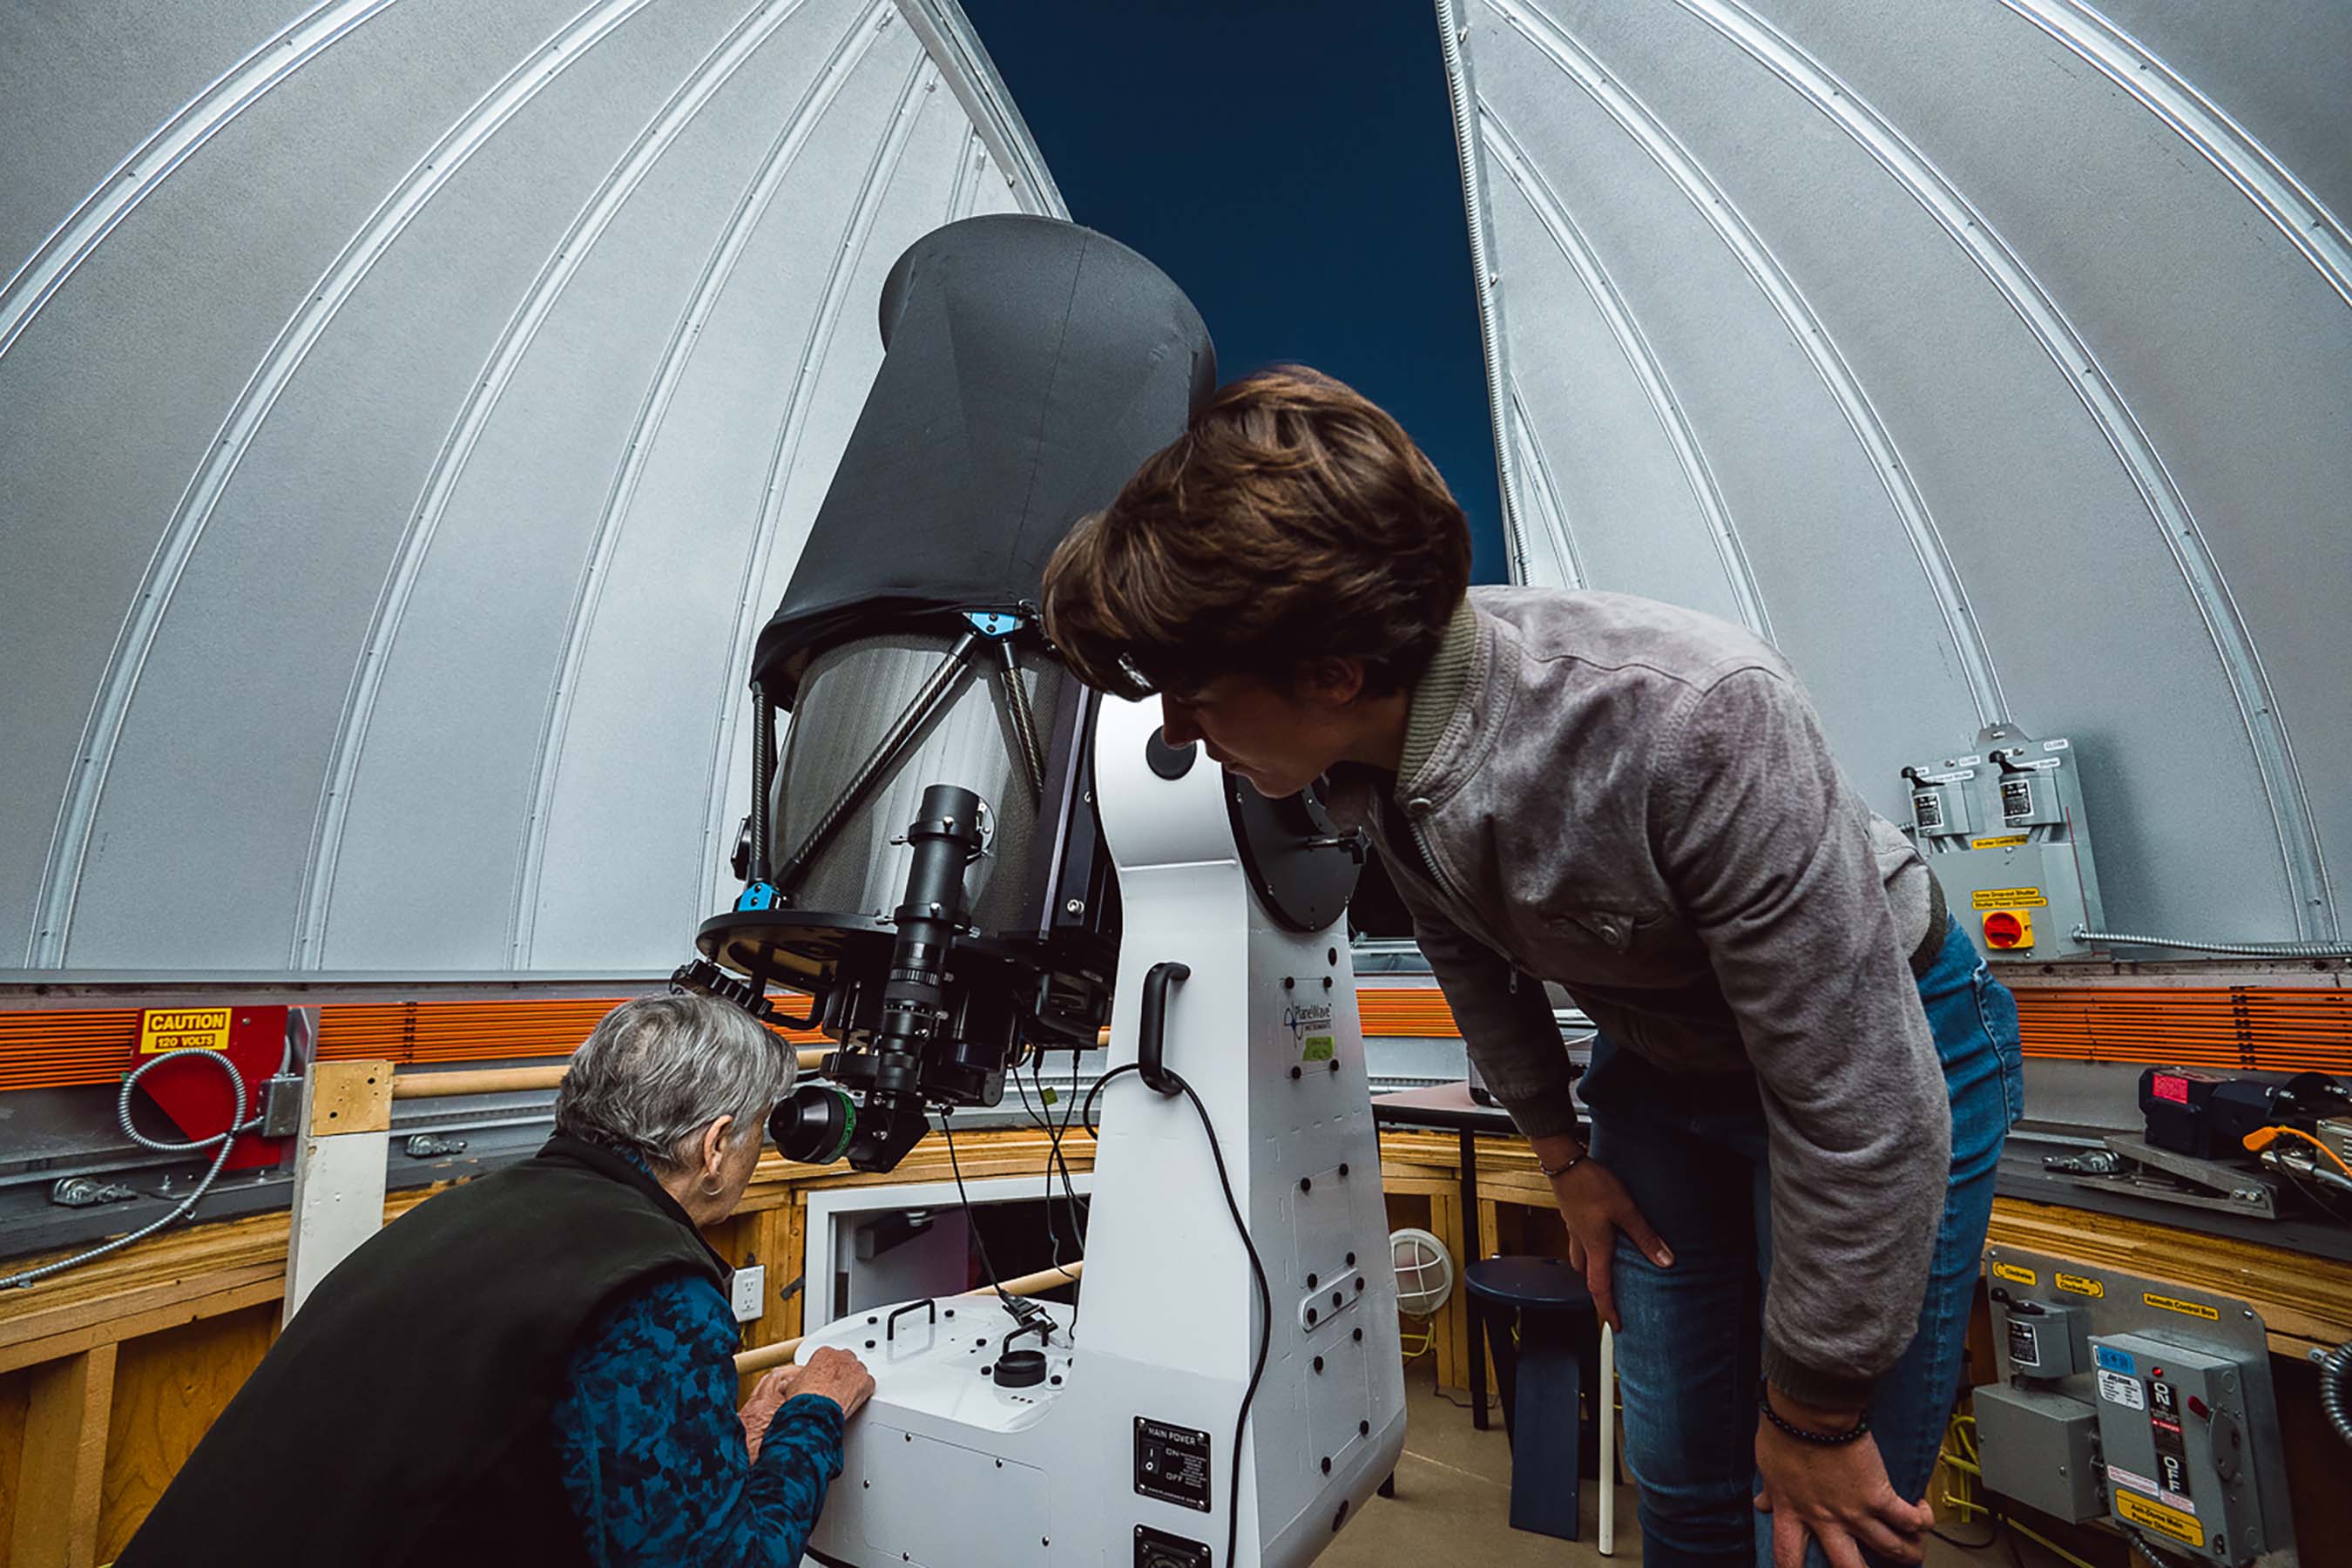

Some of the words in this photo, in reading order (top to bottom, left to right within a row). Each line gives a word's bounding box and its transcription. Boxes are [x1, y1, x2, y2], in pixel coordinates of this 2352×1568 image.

[151, 1013, 224, 1031] CAUTION
[158, 1037, 179, 1047] 120
[181, 1035, 213, 1046] VOLTS
[2146, 1295, 2173, 1307] Azimuth
[2174, 1301, 2200, 1313] Control
[2201, 1308, 2216, 1317] Box
[2153, 1382, 2172, 1406] ON
[1148, 1427, 1167, 1439] MAIN
[1169, 1431, 1196, 1446] POWER
[1166, 1448, 1179, 1457] ON
[1166, 1472, 1183, 1483] OFF
[2164, 1456, 2180, 1492] OFF
